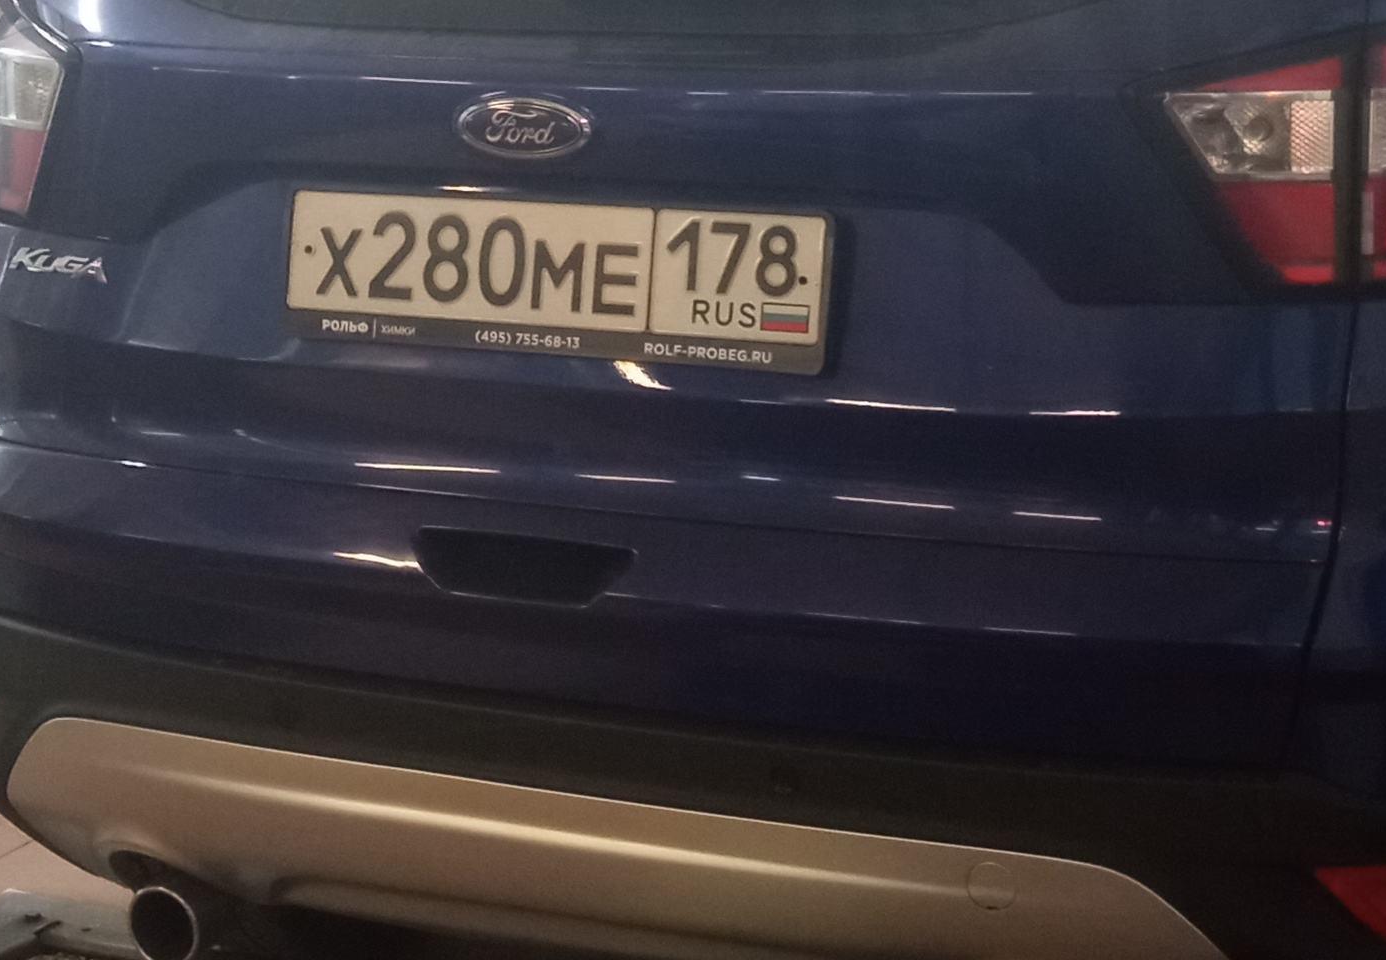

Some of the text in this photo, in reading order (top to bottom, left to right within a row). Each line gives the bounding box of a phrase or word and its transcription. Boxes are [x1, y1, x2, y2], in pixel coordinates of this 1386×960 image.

[485, 109, 555, 144] Ford
[666, 221, 797, 297] 178
[321, 318, 369, 333] РОЛЬФ
[692, 299, 756, 328] RUS
[474, 329, 581, 350] (495) 755-68-13
[643, 342, 773, 364] ROLF-PROBEG.RU
